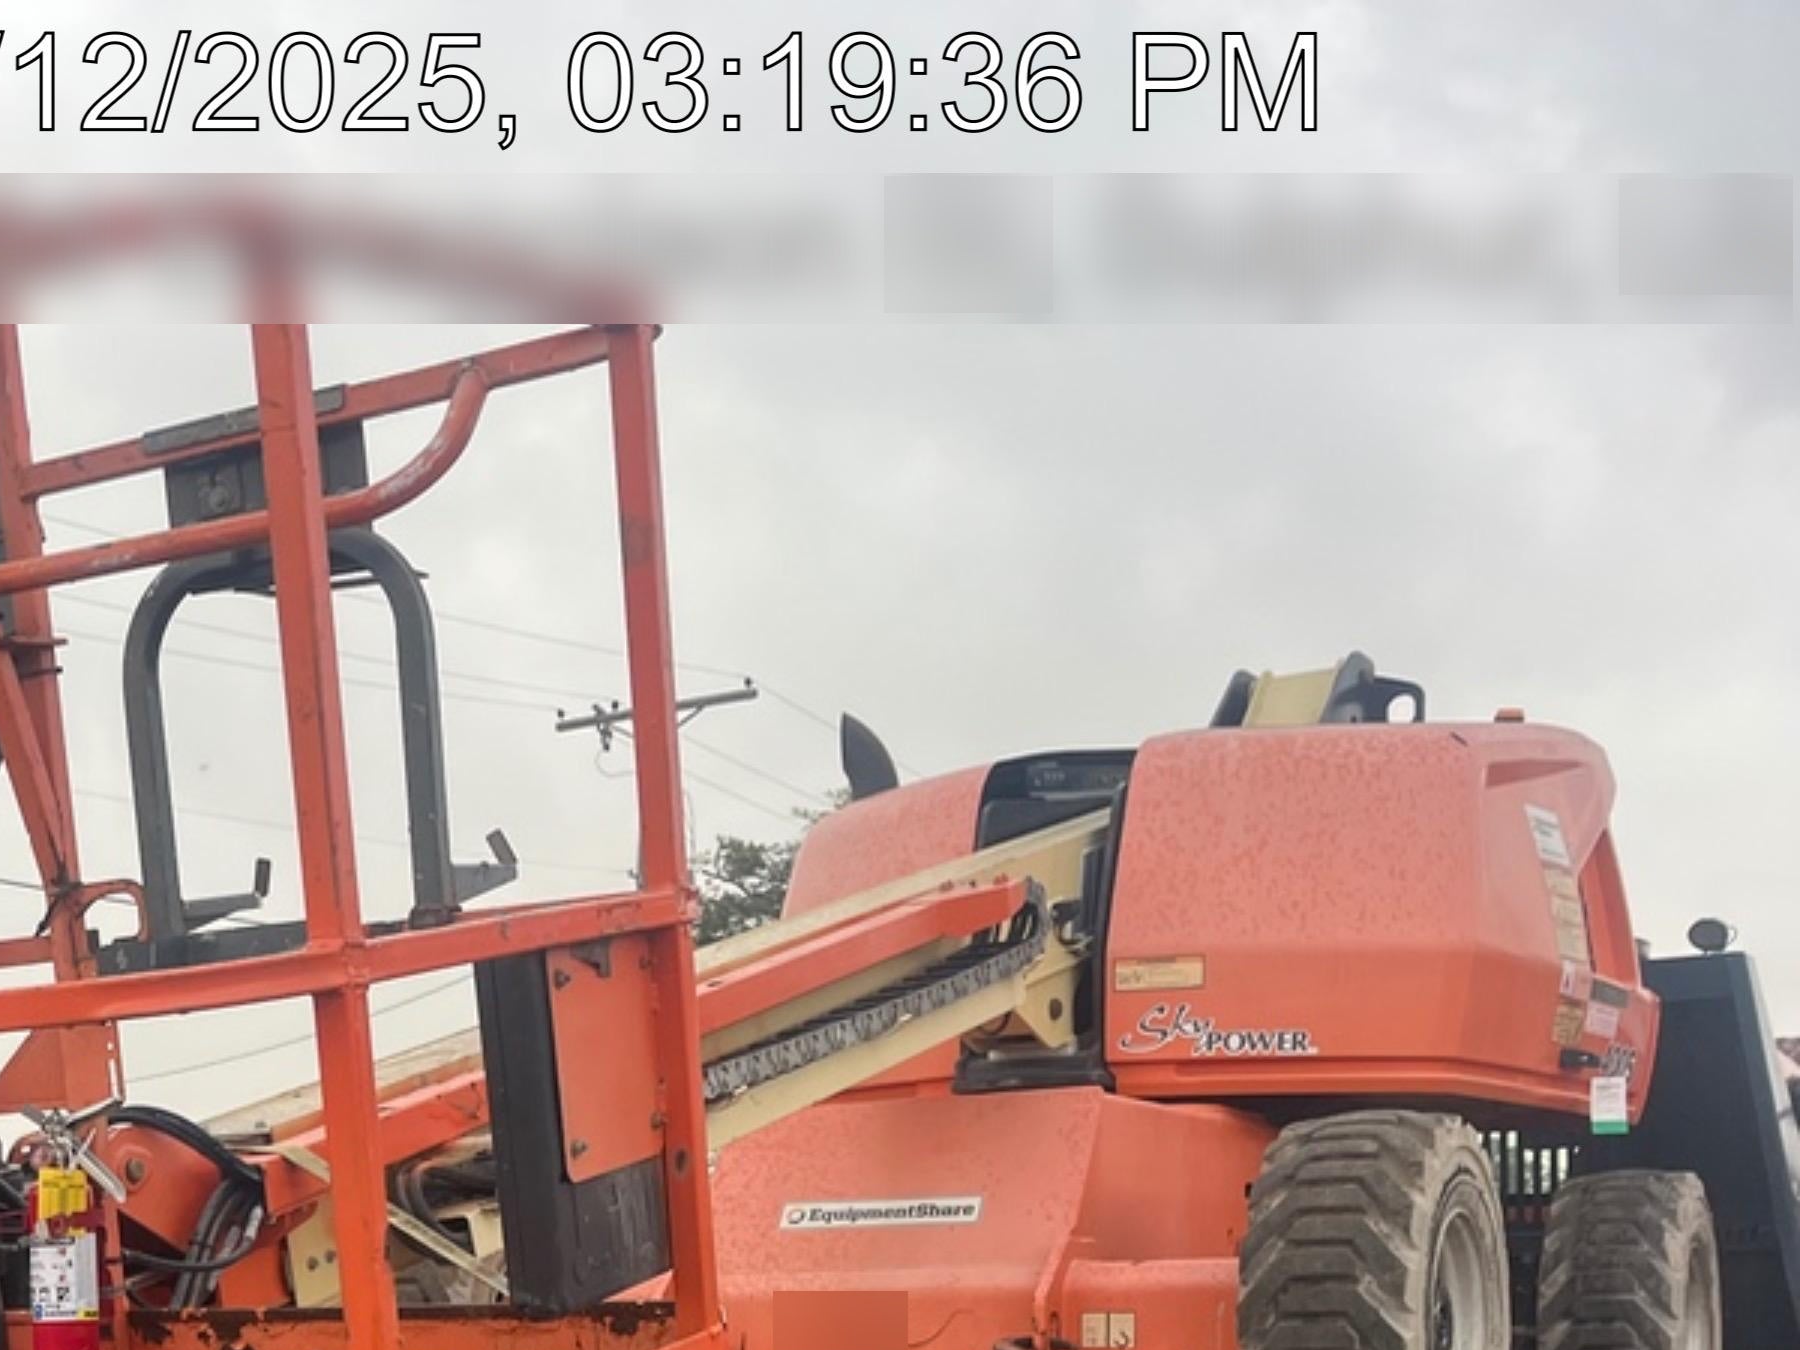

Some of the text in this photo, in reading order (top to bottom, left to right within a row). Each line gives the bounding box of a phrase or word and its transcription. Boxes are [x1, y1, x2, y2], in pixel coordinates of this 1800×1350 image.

[1120, 1003, 1312, 1055] Sky POWER
[807, 1203, 976, 1224] EquipmentShare
